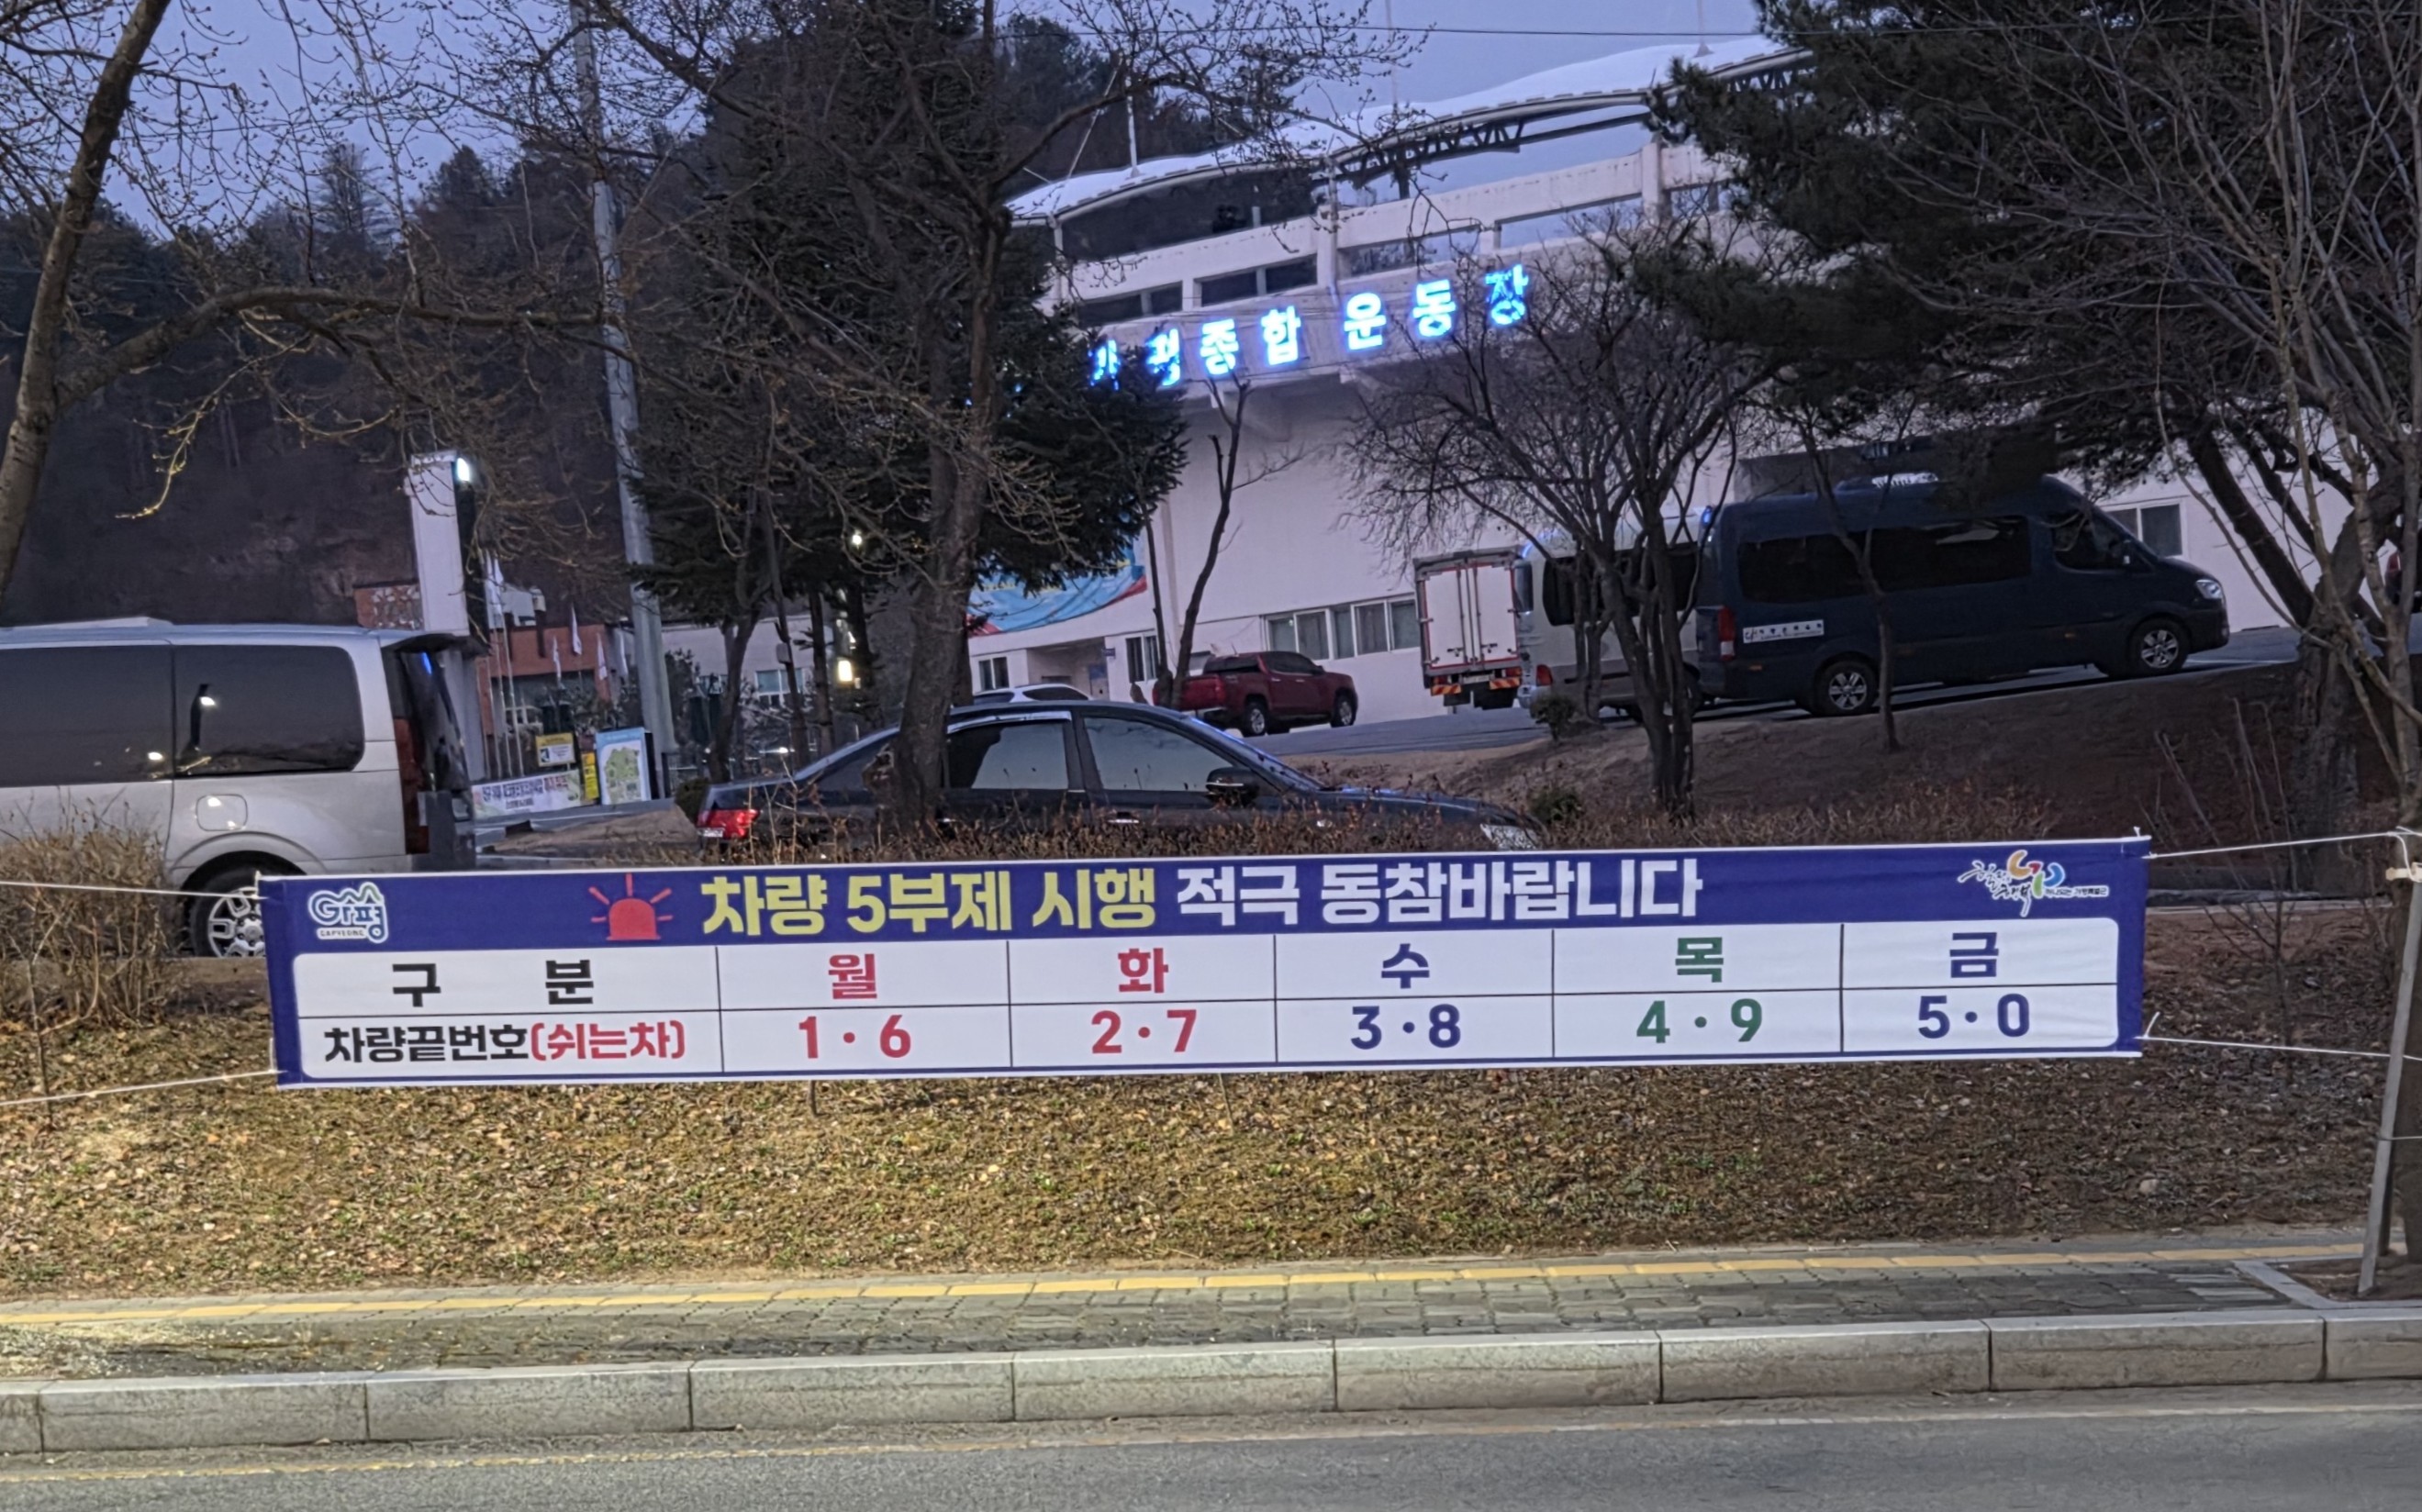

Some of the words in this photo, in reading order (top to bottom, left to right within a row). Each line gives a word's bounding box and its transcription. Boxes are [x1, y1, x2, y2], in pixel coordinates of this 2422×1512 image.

[701, 874, 827, 936] 차량
[847, 870, 1012, 932] 5부제
[1032, 868, 1155, 929] 시행
[1177, 864, 1300, 926] 적극
[1321, 858, 1703, 925] 동참바랍니다
[828, 953, 877, 999] 월
[1117, 947, 1169, 994] 화
[1380, 943, 1430, 989] 수
[1675, 936, 1724, 983] 목
[1948, 931, 1999, 979] 금
[324, 1020, 686, 1063] 차량끝번호(쉬는차)
